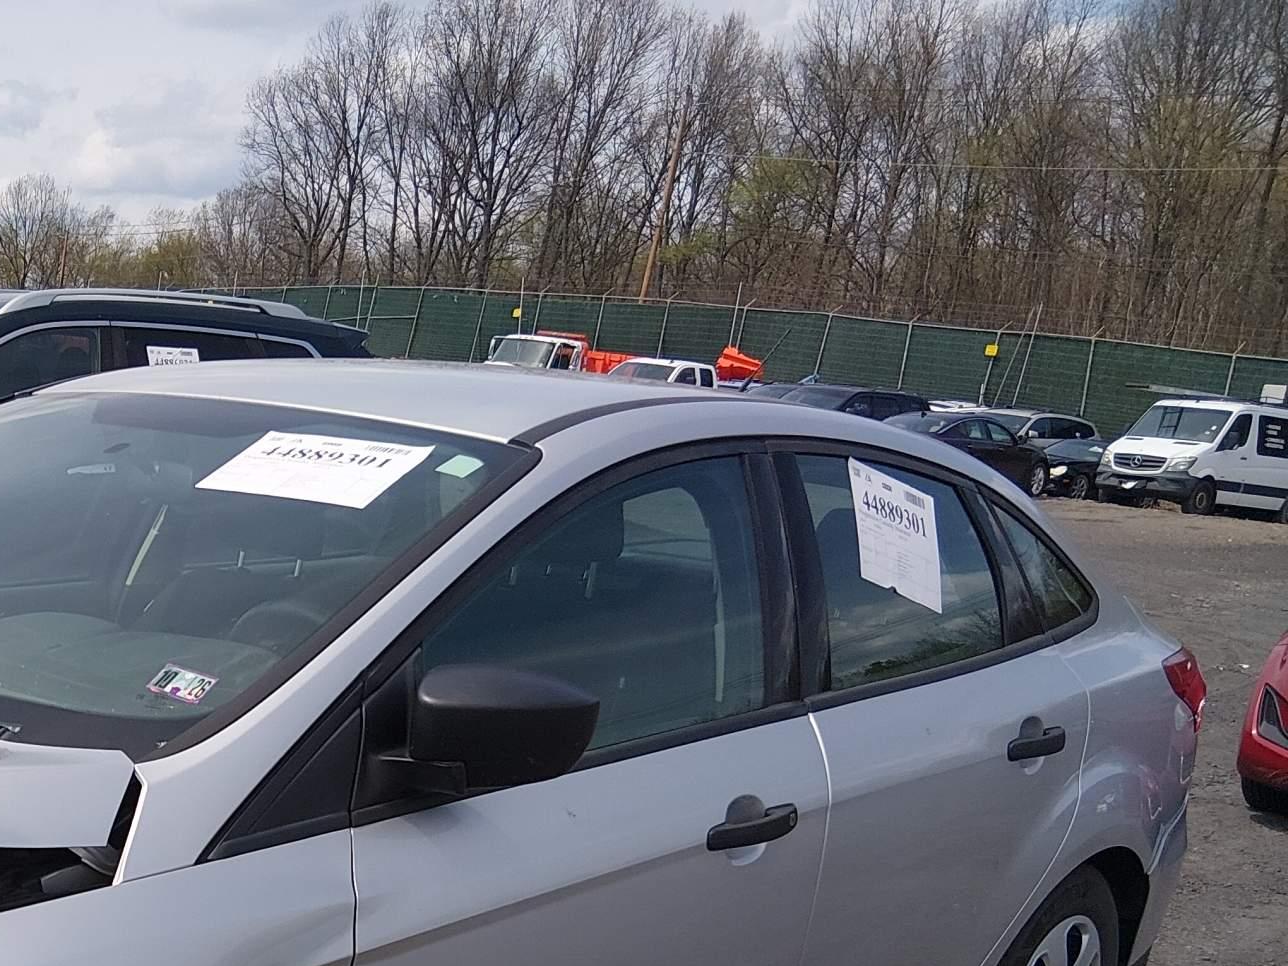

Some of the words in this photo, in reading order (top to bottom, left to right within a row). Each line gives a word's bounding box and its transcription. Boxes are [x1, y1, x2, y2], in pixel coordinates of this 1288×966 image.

[261, 446, 394, 469] 44889301
[862, 490, 928, 539] 44889301
[188, 678, 212, 699] 26
